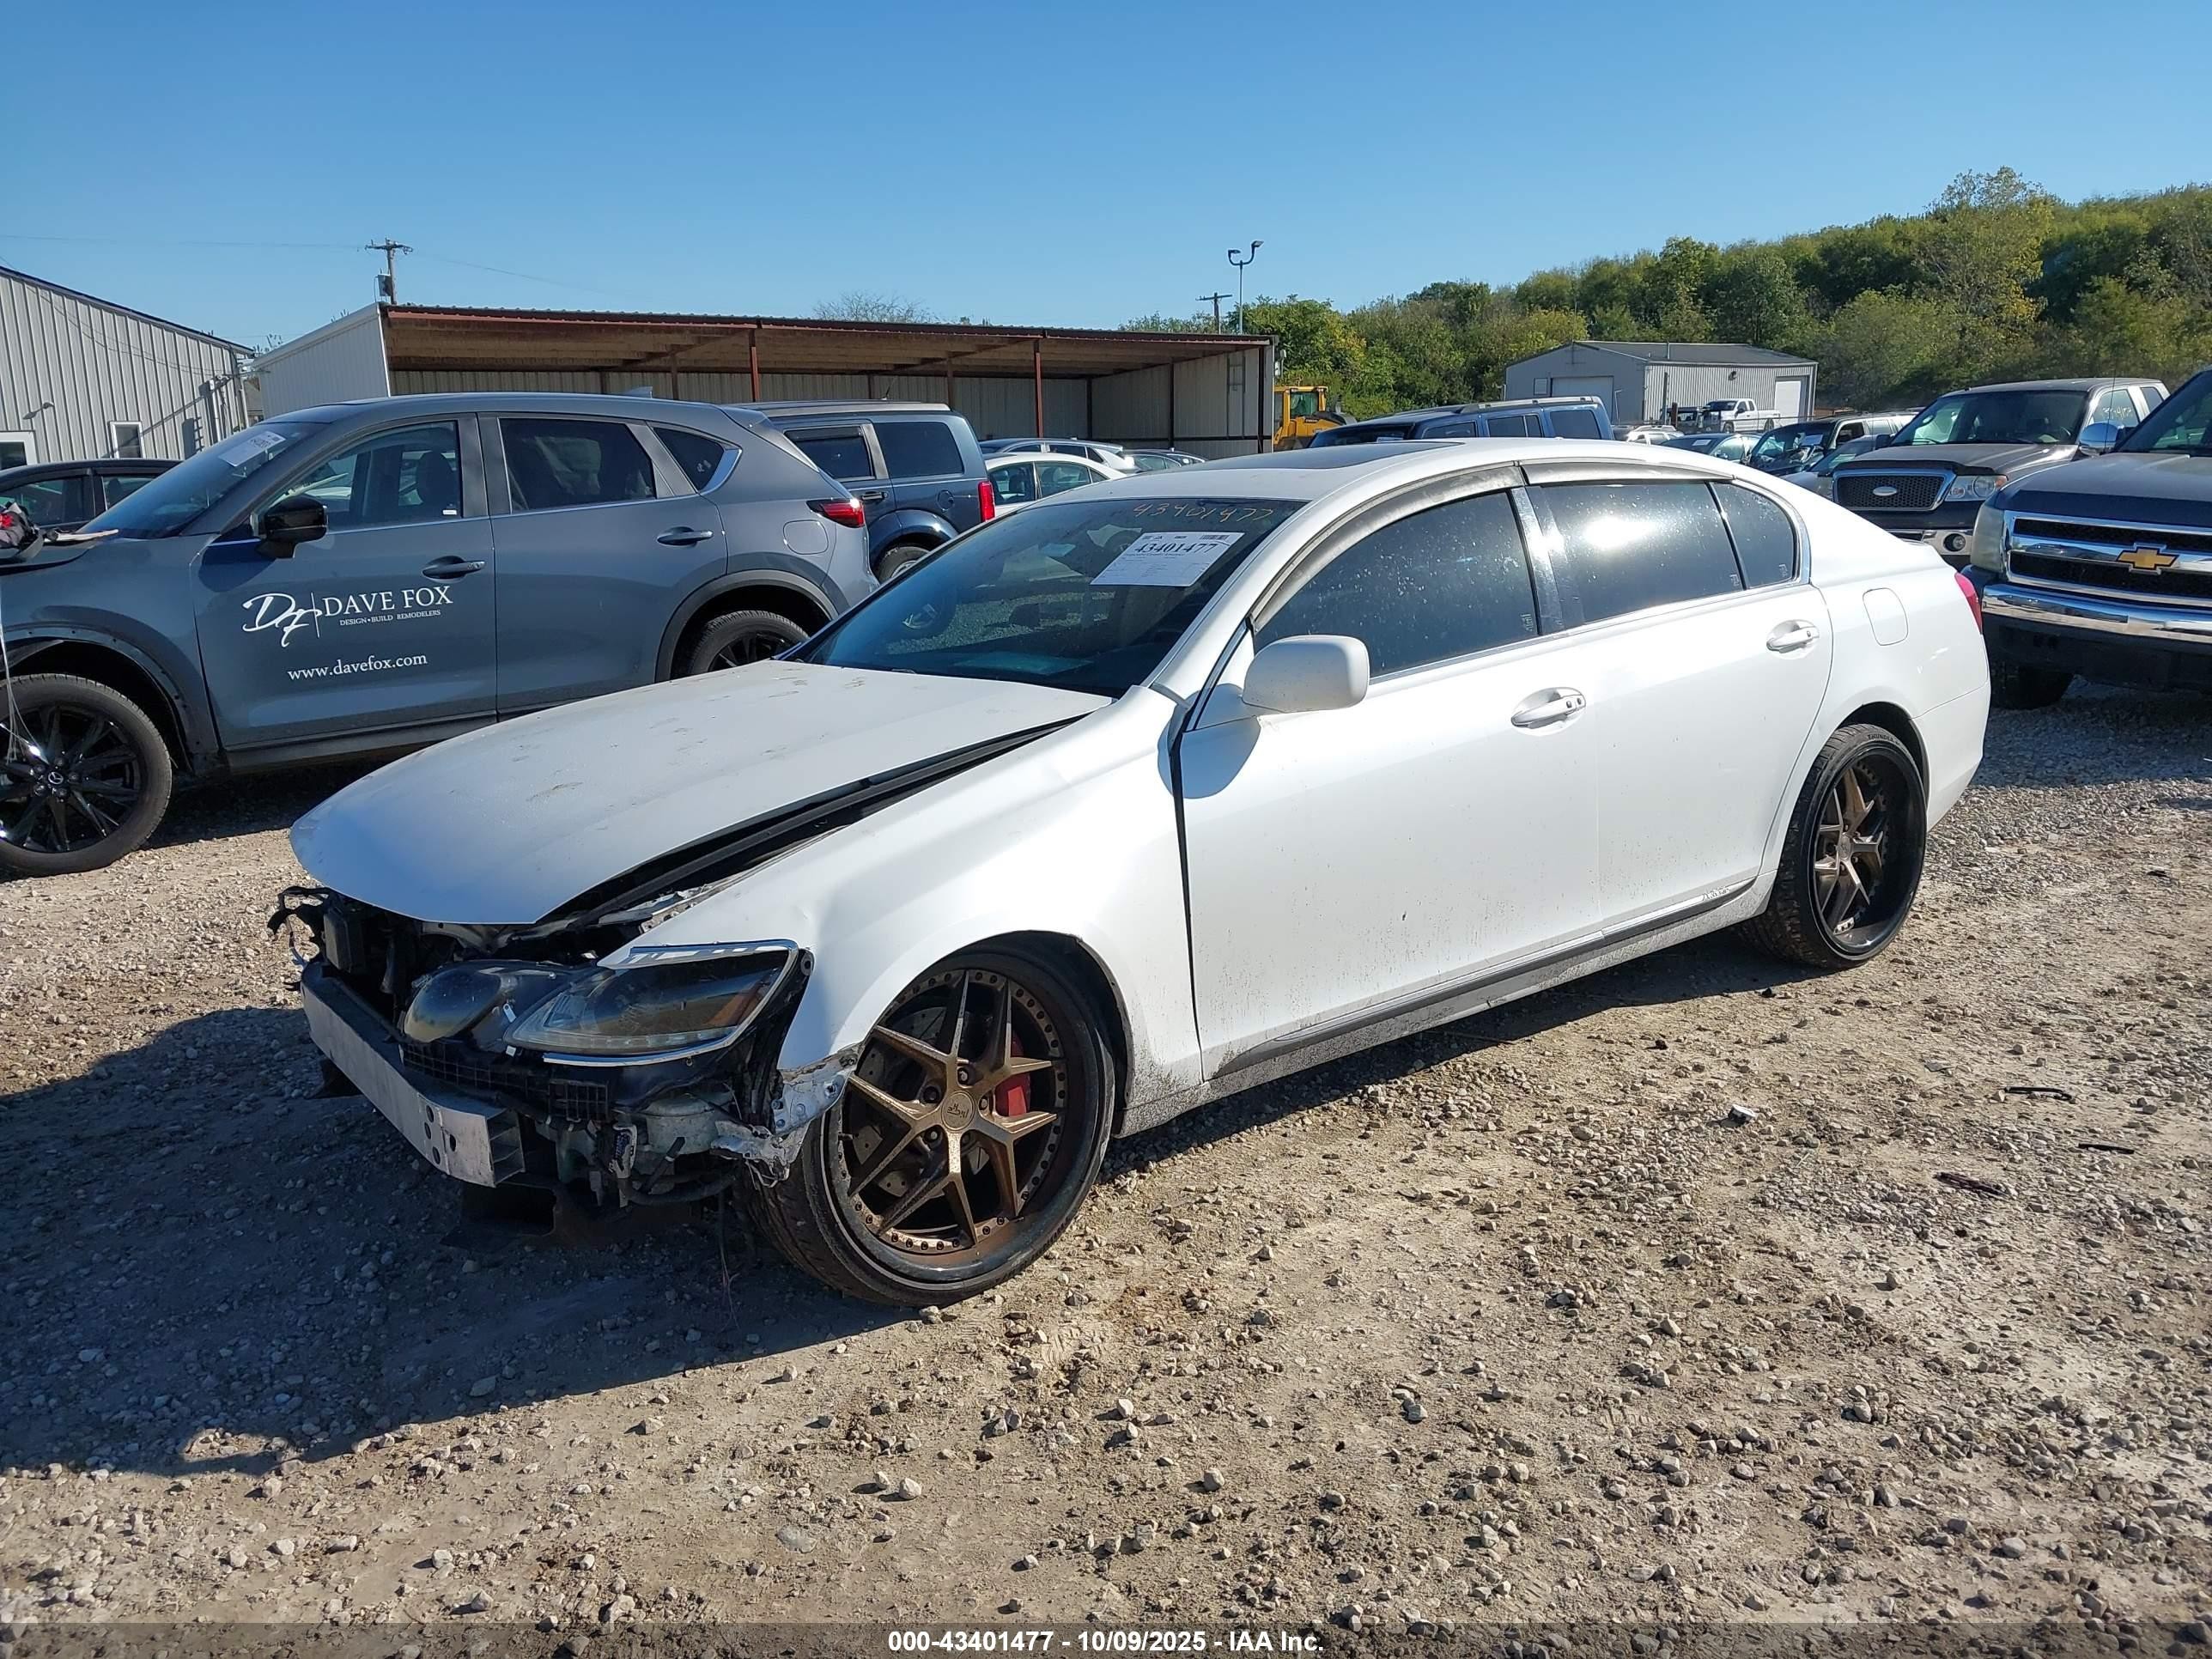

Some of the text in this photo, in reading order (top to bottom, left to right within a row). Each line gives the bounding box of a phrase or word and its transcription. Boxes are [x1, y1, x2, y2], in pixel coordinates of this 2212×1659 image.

[1134, 543, 1218, 554] 43401477
[322, 586, 453, 617] DAVE FOX
[396, 609, 441, 621] REMODELERS
[287, 655, 428, 680] www.davefox.com
